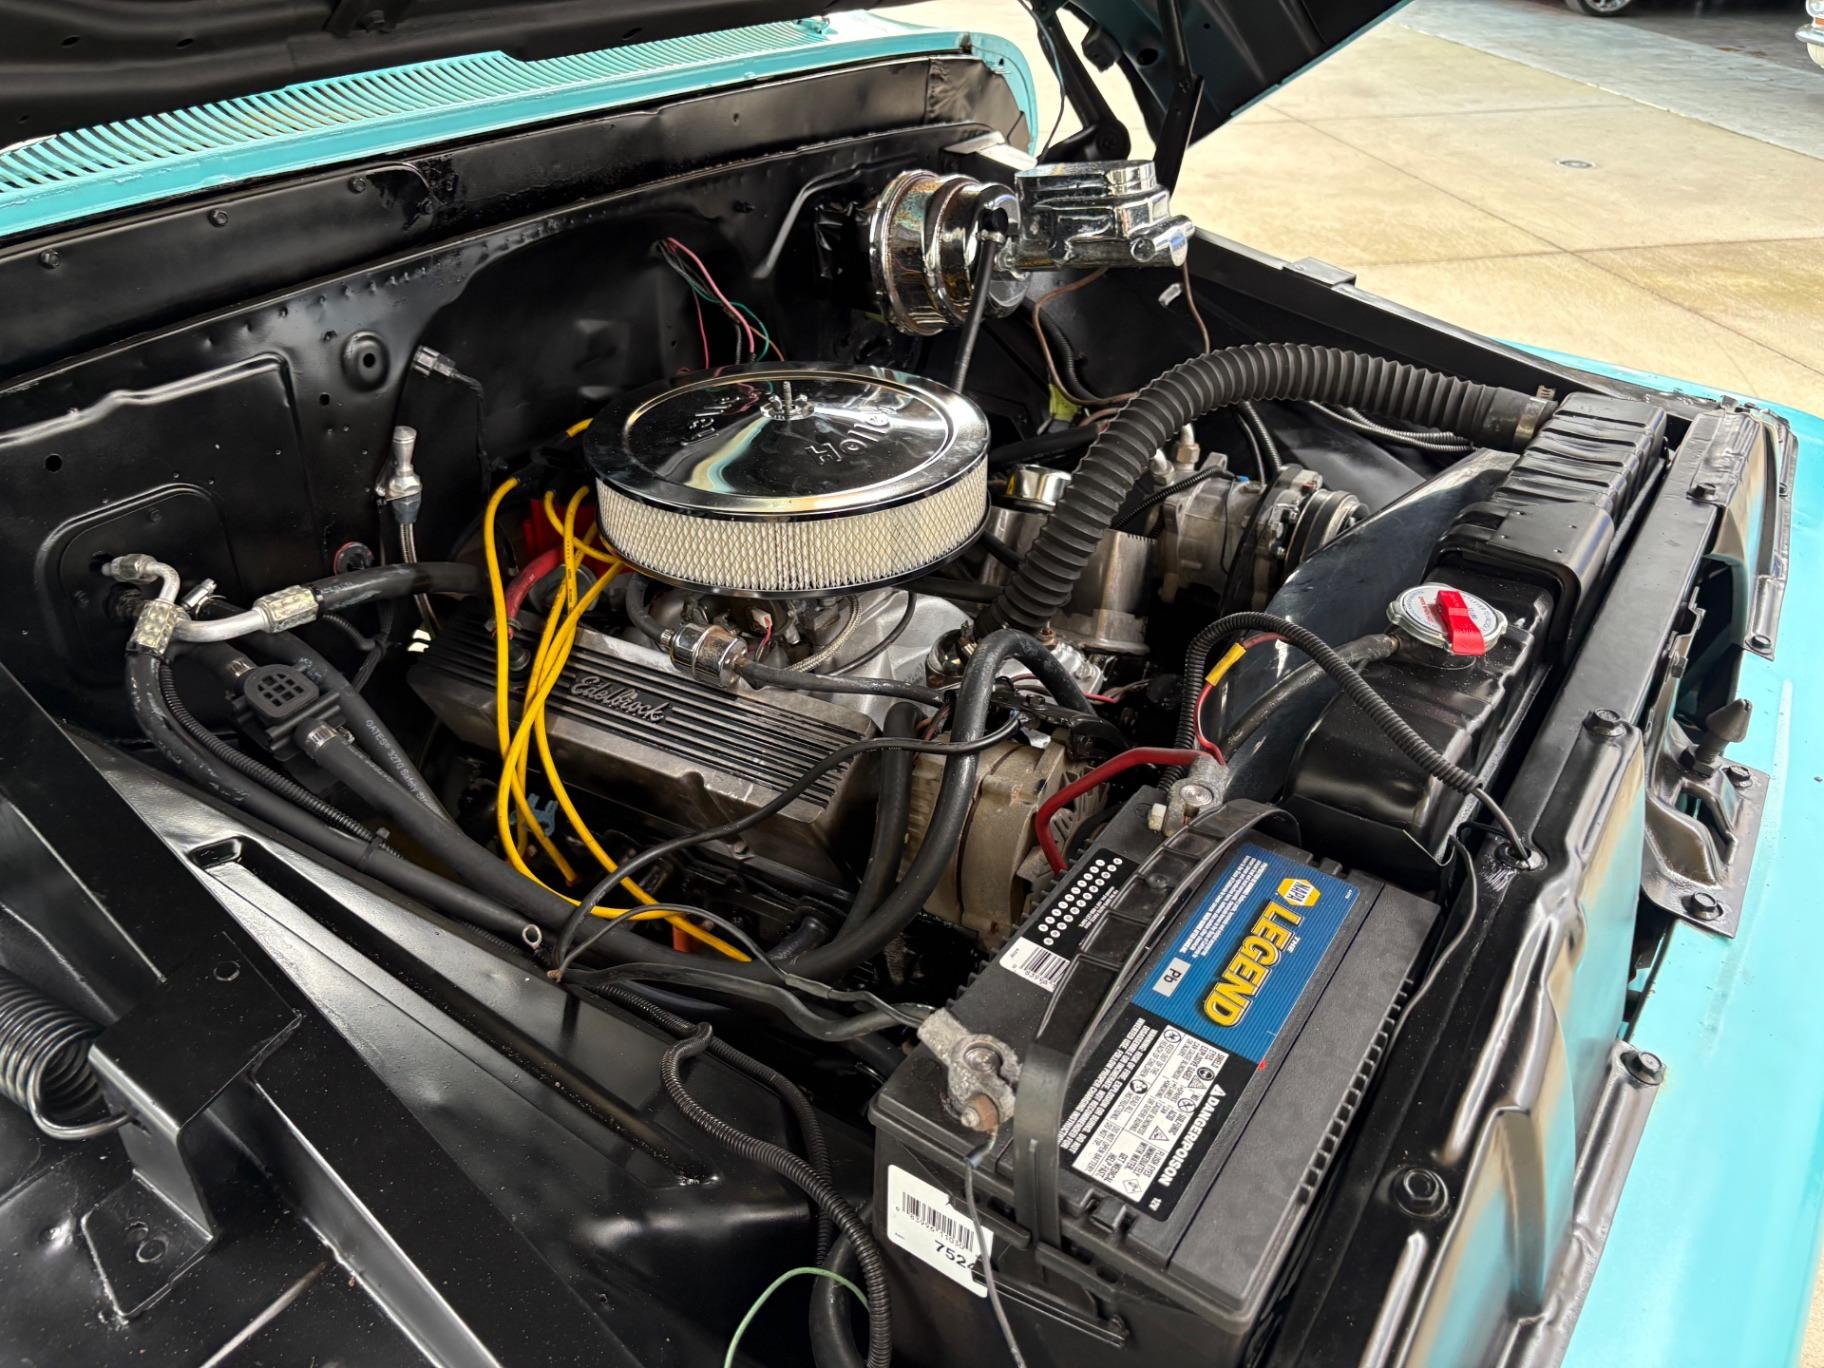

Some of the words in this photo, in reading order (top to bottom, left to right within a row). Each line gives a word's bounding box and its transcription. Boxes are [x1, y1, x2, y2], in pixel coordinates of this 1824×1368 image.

[571, 675, 670, 723] Edelbrock
[387, 749, 405, 769] 3270
[400, 769, 418, 791] Safety
[1285, 880, 1311, 903] NAPA
[1287, 937, 1300, 953] THE
[1163, 968, 1182, 983] Pb
[1203, 901, 1304, 1027] LEGEND
[1157, 1096, 1219, 1186] DANGER/POISON
[1147, 1197, 1162, 1211] 12V
